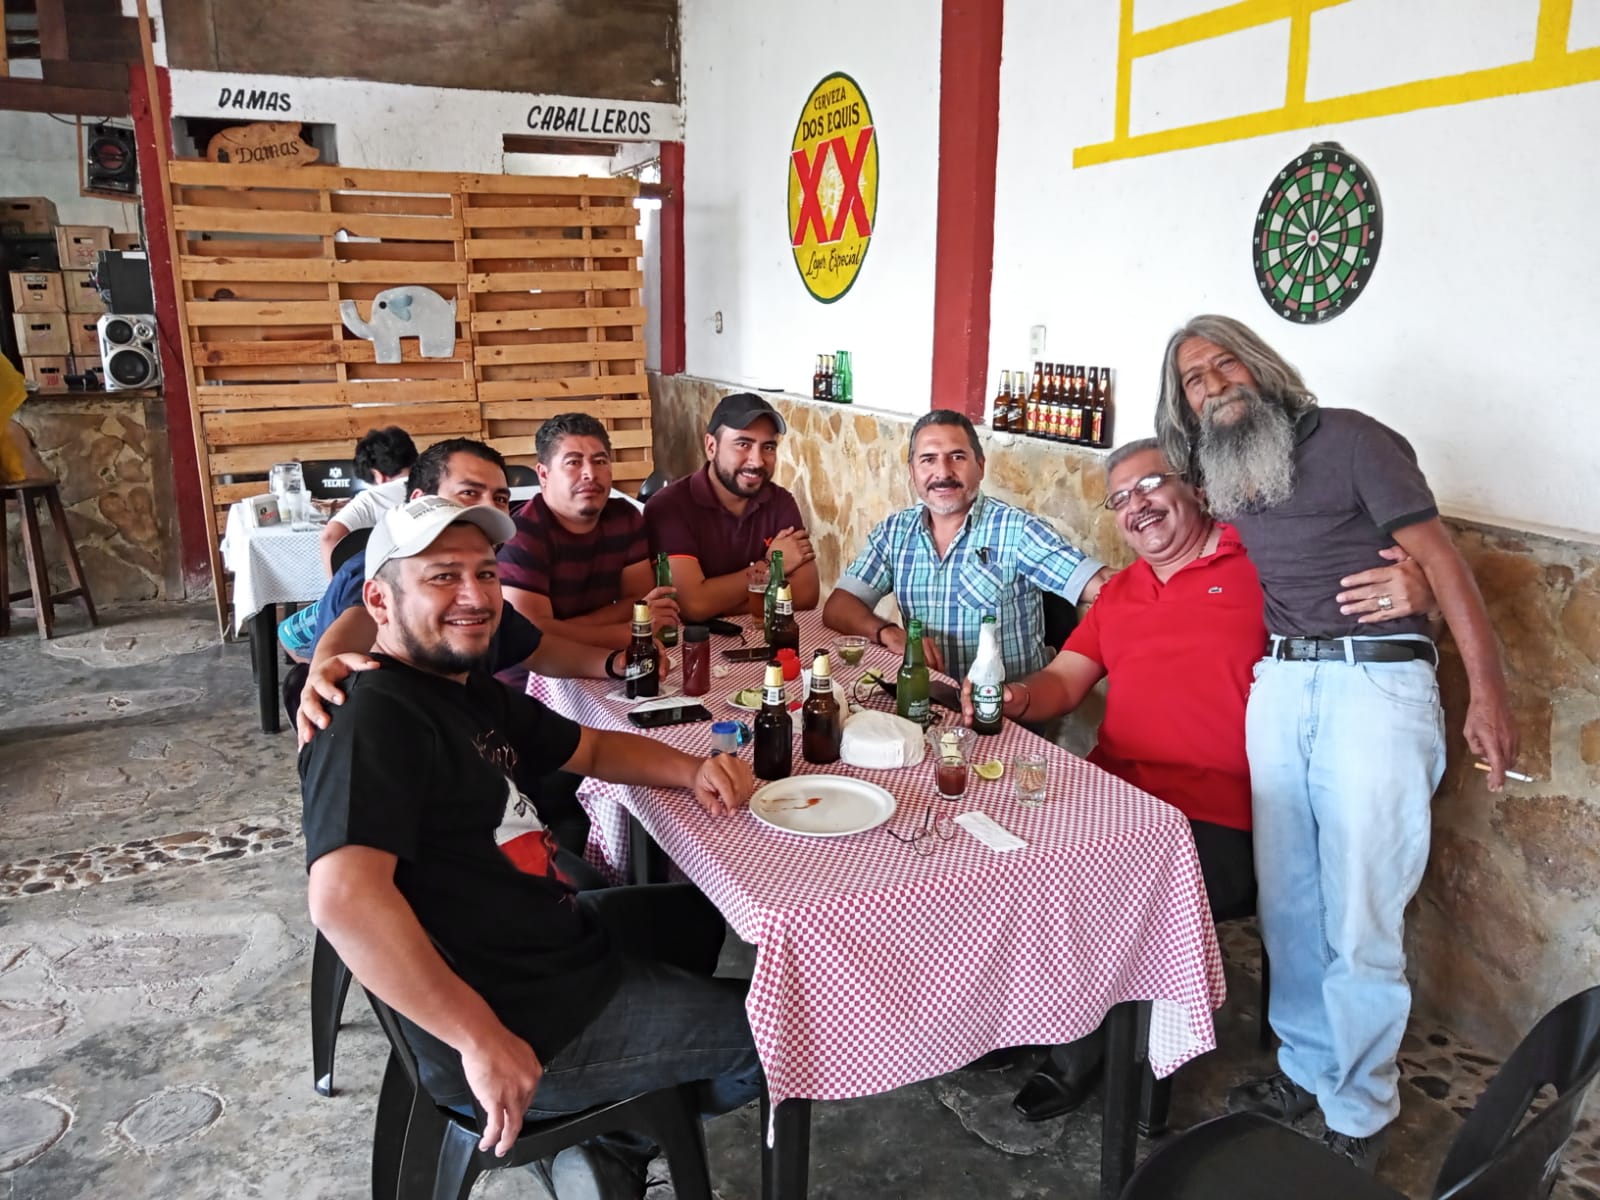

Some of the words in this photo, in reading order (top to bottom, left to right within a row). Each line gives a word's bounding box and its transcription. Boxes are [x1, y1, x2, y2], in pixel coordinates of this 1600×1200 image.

[217, 87, 292, 112] DAMAS
[813, 86, 847, 111] CERVEZA
[526, 105, 651, 135] CABALLEROS
[802, 115, 825, 142] DOS
[827, 101, 860, 133] EQUIS
[235, 140, 300, 164] Damas
[1313, 152, 1323, 160] 20
[790, 124, 875, 248] XX
[805, 250, 826, 280] Lager
[828, 243, 862, 279] Especial
[321, 478, 351, 488] TECATE
